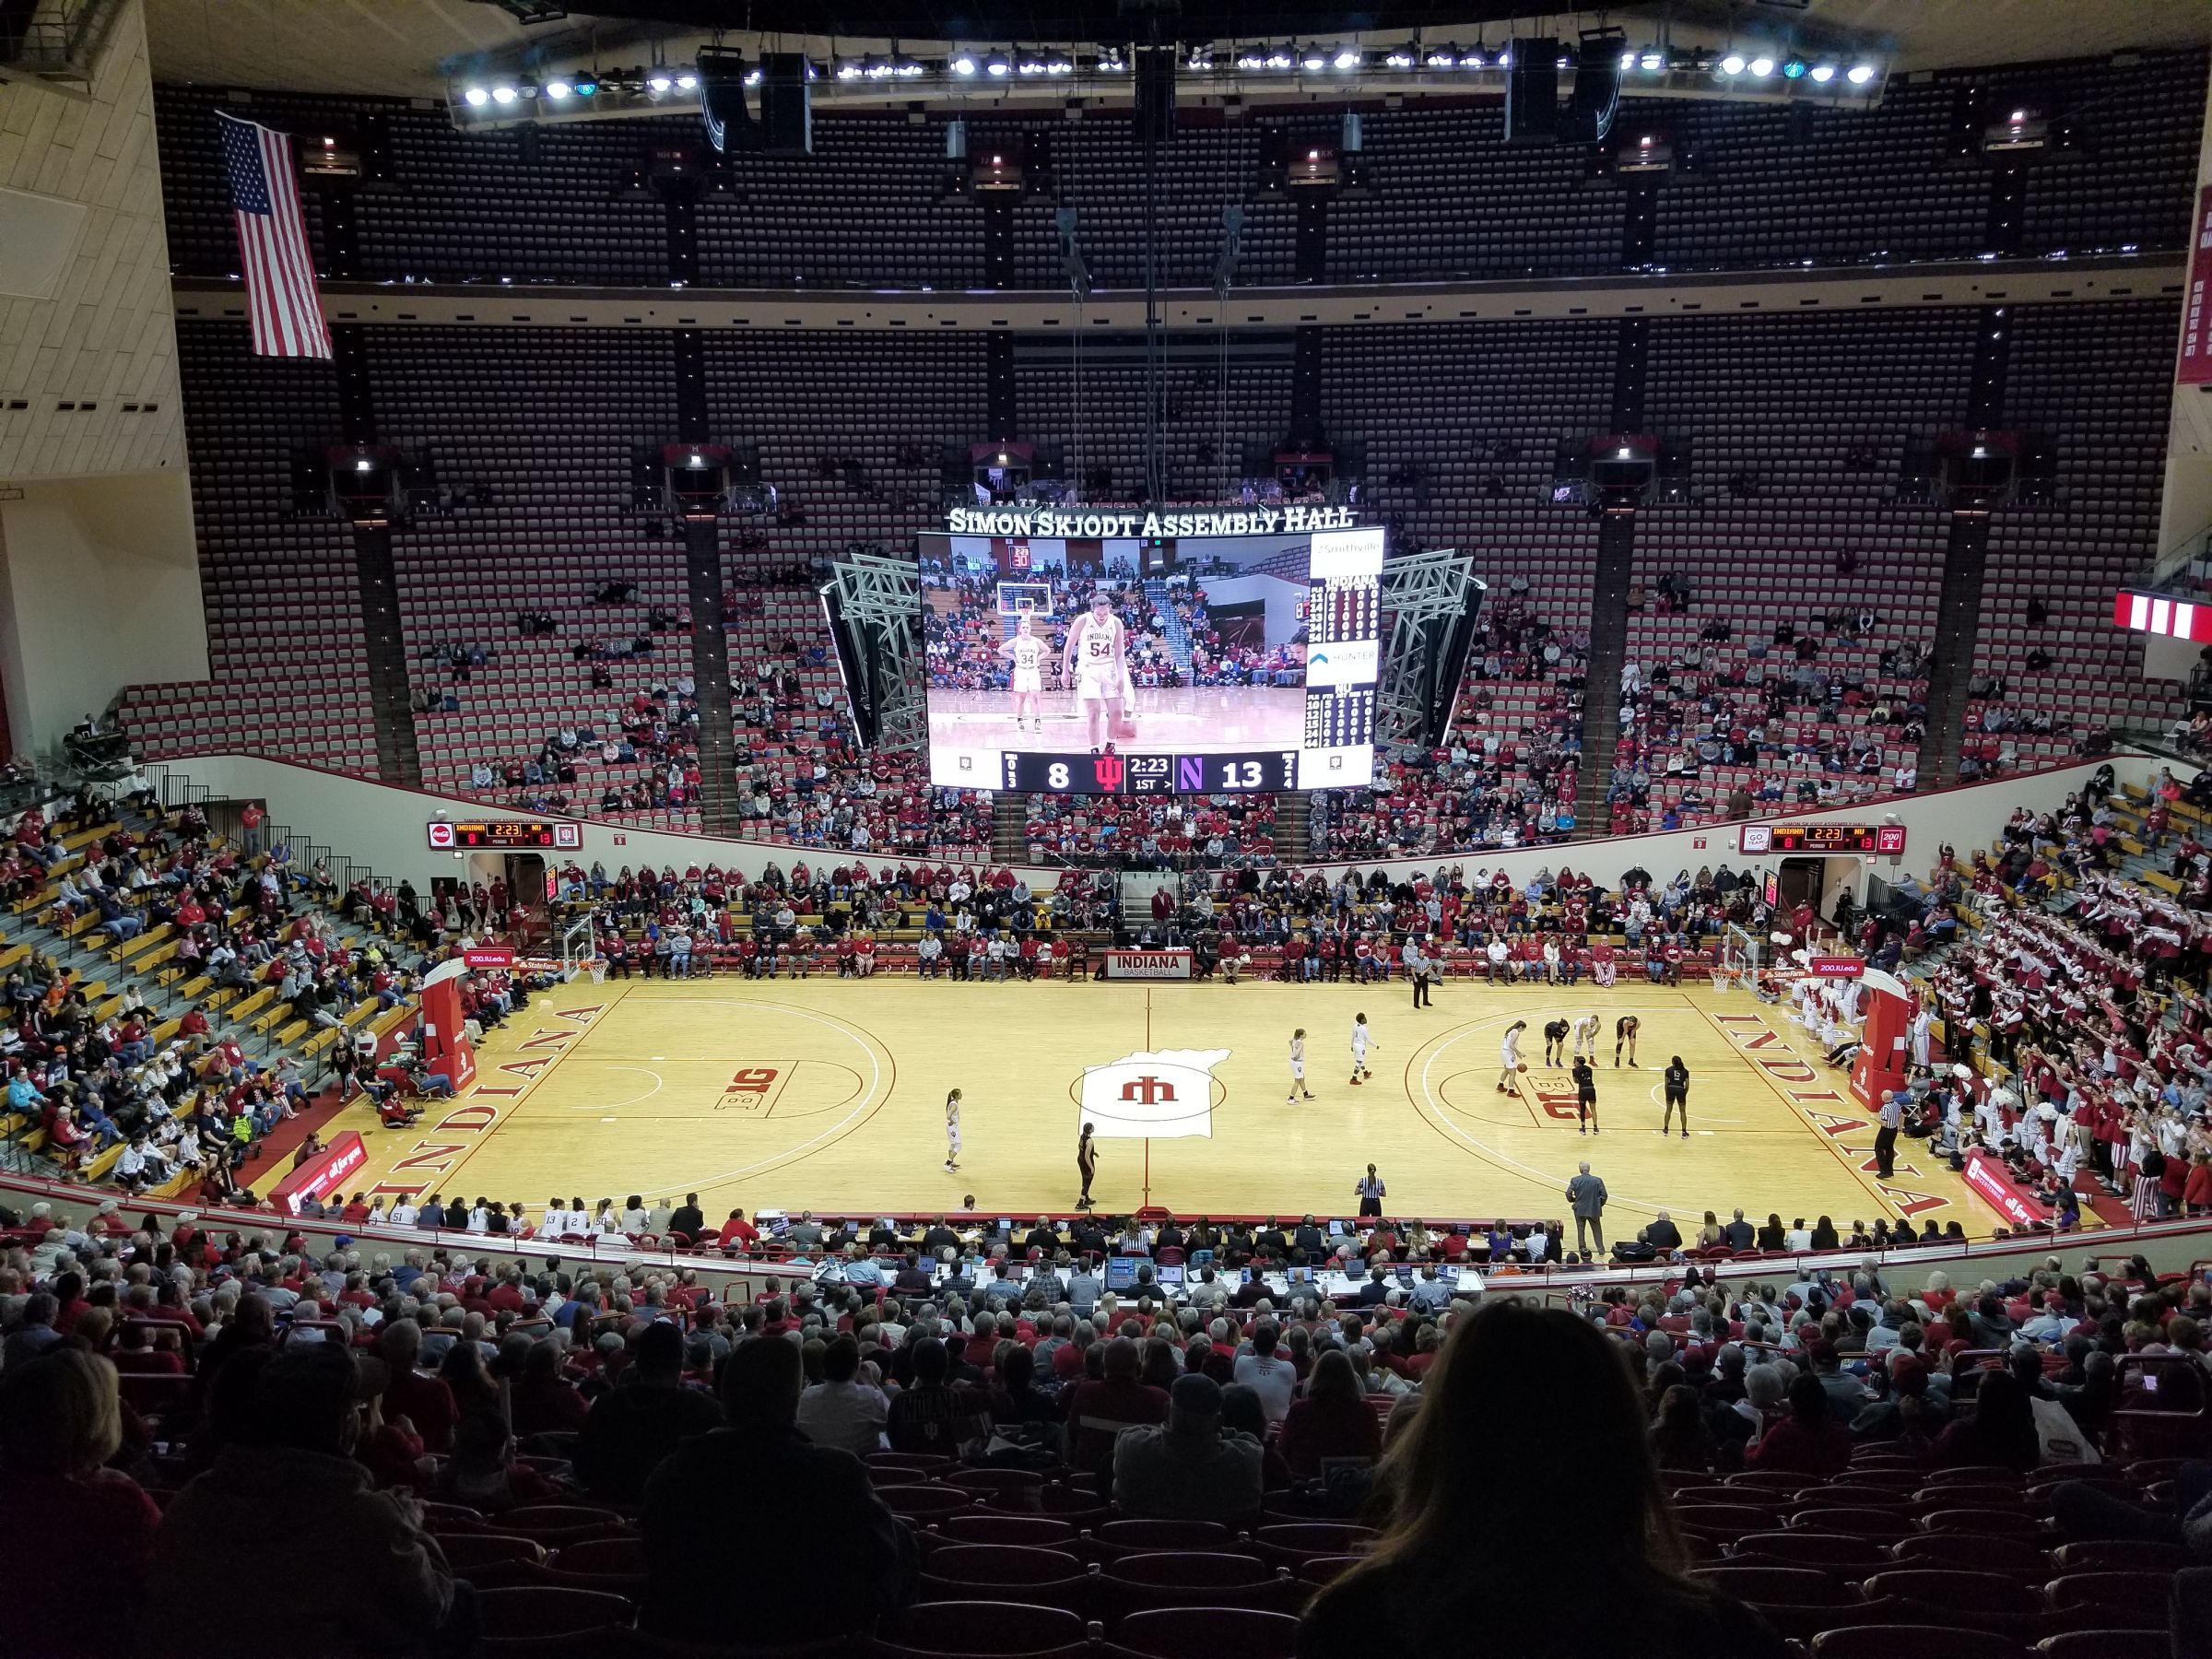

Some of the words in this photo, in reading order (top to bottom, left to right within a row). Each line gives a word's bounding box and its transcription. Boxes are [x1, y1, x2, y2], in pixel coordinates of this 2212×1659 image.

[949, 508, 1031, 535] SIMON
[1037, 511, 1135, 536] SKJODT
[1142, 512, 1279, 536] ASSEMBLY
[1283, 506, 1353, 532] HALL
[1014, 555, 1028, 568] 30
[1324, 574, 1377, 588] INDIANA
[1311, 593, 1323, 602] 11
[1329, 592, 1336, 601] 0
[1344, 592, 1349, 601] 1
[1357, 590, 1364, 600] 0
[1371, 590, 1378, 599] 0
[1311, 603, 1323, 612] 14
[1329, 602, 1335, 611] 2
[1344, 601, 1349, 610] 1
[1357, 601, 1364, 609] 0
[1370, 599, 1377, 608] 0
[1309, 613, 1322, 622] 33
[1327, 612, 1335, 621] 0
[1342, 612, 1349, 621] 0
[1357, 610, 1364, 619] 0
[1370, 610, 1377, 619] 0
[1309, 623, 1322, 632] 34
[1327, 622, 1335, 631] 2
[1342, 621, 1349, 630] 0
[1356, 621, 1363, 629] 0
[1370, 619, 1377, 629] 0
[1309, 632, 1322, 642] 54
[1327, 632, 1335, 641] 4
[1342, 632, 1349, 641] 0
[1356, 630, 1362, 640] 3
[1370, 630, 1376, 640] 0
[1090, 642, 1111, 656] 54
[1021, 653, 1033, 664] 34
[1334, 651, 1374, 661] HUNTER
[1335, 684, 1352, 694] NU
[1307, 700, 1320, 710] 10
[1325, 700, 1332, 709] 5
[1338, 699, 1345, 708] 2
[1352, 699, 1359, 707] 1
[1365, 697, 1372, 706] 0
[1307, 711, 1319, 719] 12
[1324, 710, 1331, 719] 0
[1338, 710, 1345, 718] 1
[1351, 708, 1359, 717] 0
[1364, 707, 1371, 715] 0
[1306, 721, 1319, 729] 15
[1324, 719, 1331, 728] 2
[1336, 719, 1344, 727] 0
[1350, 717, 1358, 726] 0
[1364, 717, 1371, 725] 1
[1305, 730, 1318, 738] 24
[1324, 728, 1331, 737] 0
[1336, 728, 1344, 737] 0
[1349, 726, 1357, 735] 0
[1364, 726, 1371, 735] 0
[1305, 739, 1318, 747] 44
[1324, 738, 1330, 747] 2
[1336, 737, 1344, 747] 0
[1351, 736, 1357, 746] 1
[1364, 735, 1370, 745] 1
[1007, 759, 1016, 770] 0
[1130, 758, 1168, 773] 2:23
[1284, 759, 1293, 771] 2
[1048, 762, 1069, 788] 8
[1181, 757, 1202, 790] N
[1222, 761, 1262, 788] 13
[1008, 777, 1017, 788] 3
[1135, 779, 1156, 790] 1ST
[1284, 778, 1292, 789] 4
[496, 825, 519, 835] 2:23
[1815, 829, 1841, 839] 2:23
[467, 833, 476, 844] 8
[539, 833, 550, 844] 13
[1784, 838, 1792, 848] 8
[1861, 838, 1872, 848] 13
[1117, 956, 1180, 969] INDIANA
[1124, 968, 1172, 976] BASKETBALL
[365, 1003, 607, 1200] INDIANA
[1710, 1012, 1953, 1220] INDIANA
[348, 1146, 361, 1164] you
[2005, 1197, 2016, 1211] all
[394, 1213, 402, 1222] 51
[547, 1216, 555, 1225] 13
[571, 1218, 577, 1226] 2
